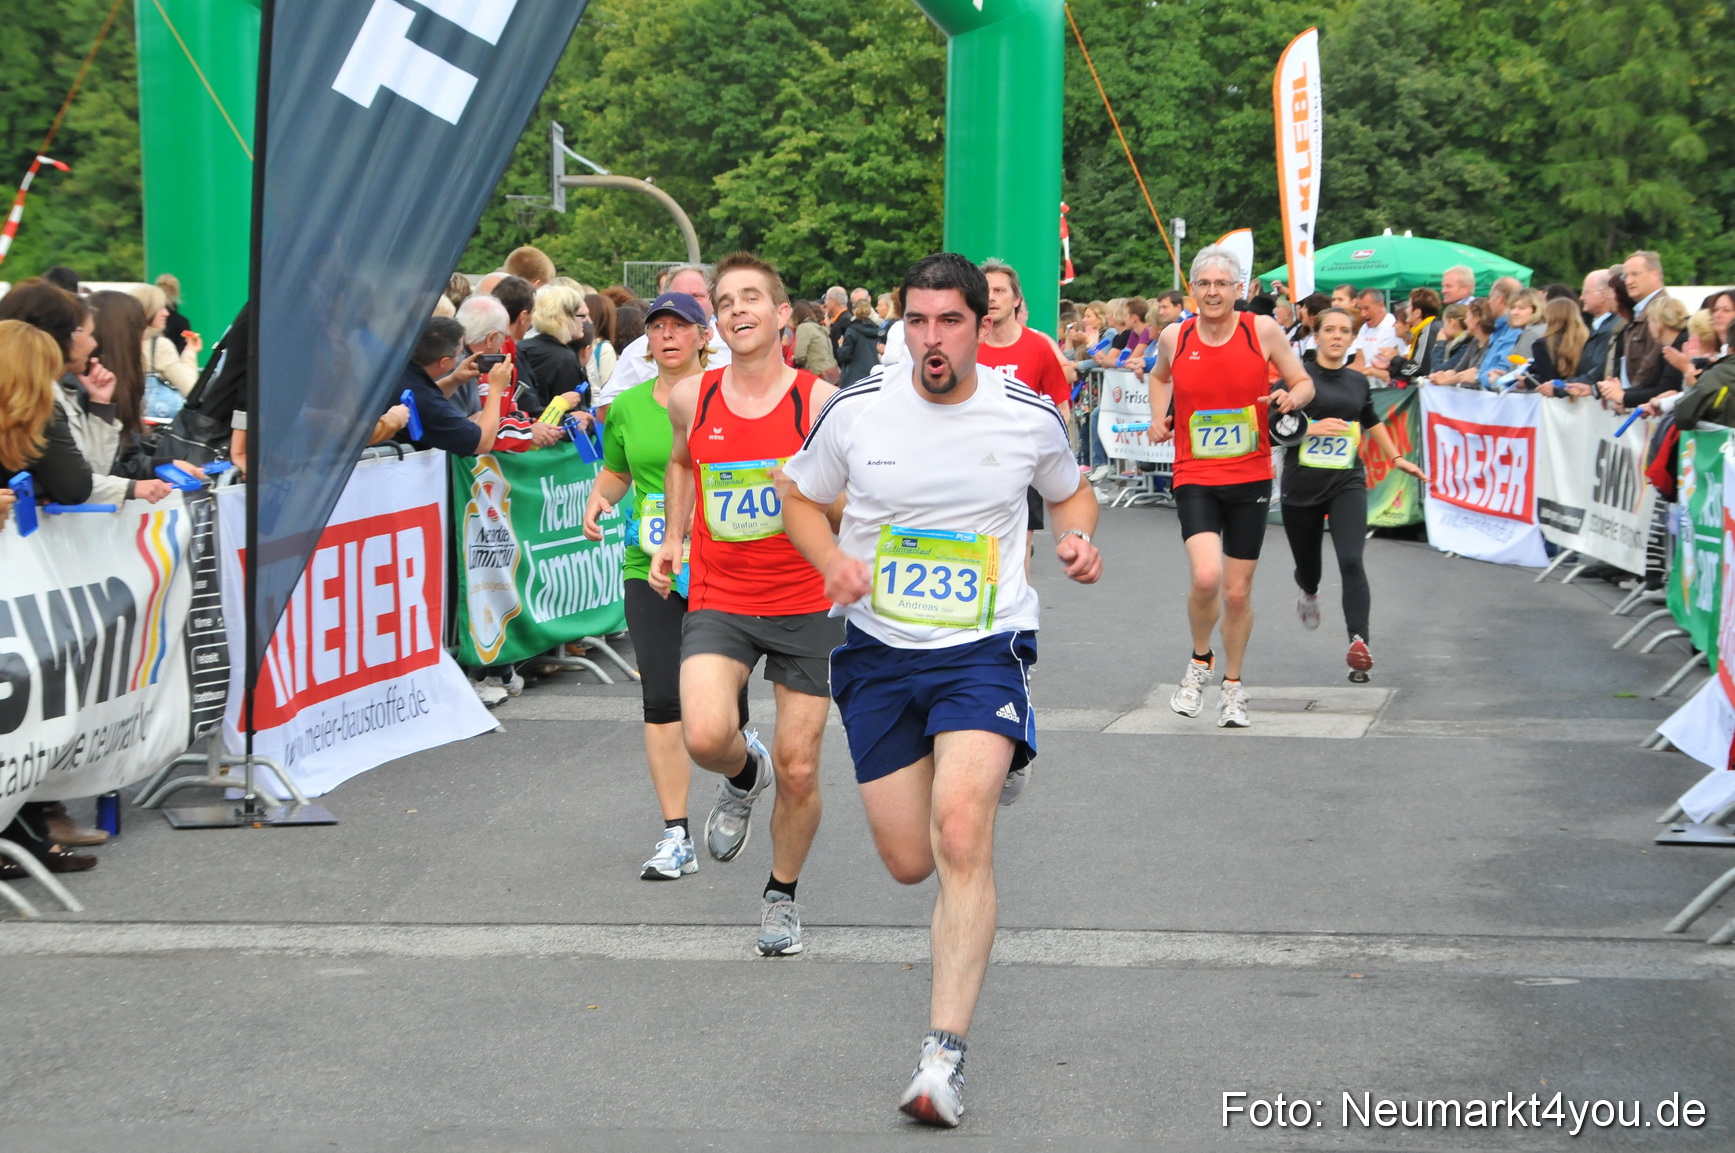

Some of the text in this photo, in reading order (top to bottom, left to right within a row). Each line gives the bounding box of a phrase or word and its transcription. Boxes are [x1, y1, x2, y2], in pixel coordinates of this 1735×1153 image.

[1292, 61, 1313, 212] KLEBL
[1124, 390, 1150, 405] Frisc
[1198, 425, 1241, 447] 721
[1307, 436, 1348, 456] 252
[1433, 423, 1529, 516] MEIER
[713, 486, 782, 522] 740
[649, 517, 666, 545] 8
[732, 522, 758, 530] Stefan
[880, 560, 978, 603] 1233
[898, 599, 939, 612] Andreas
